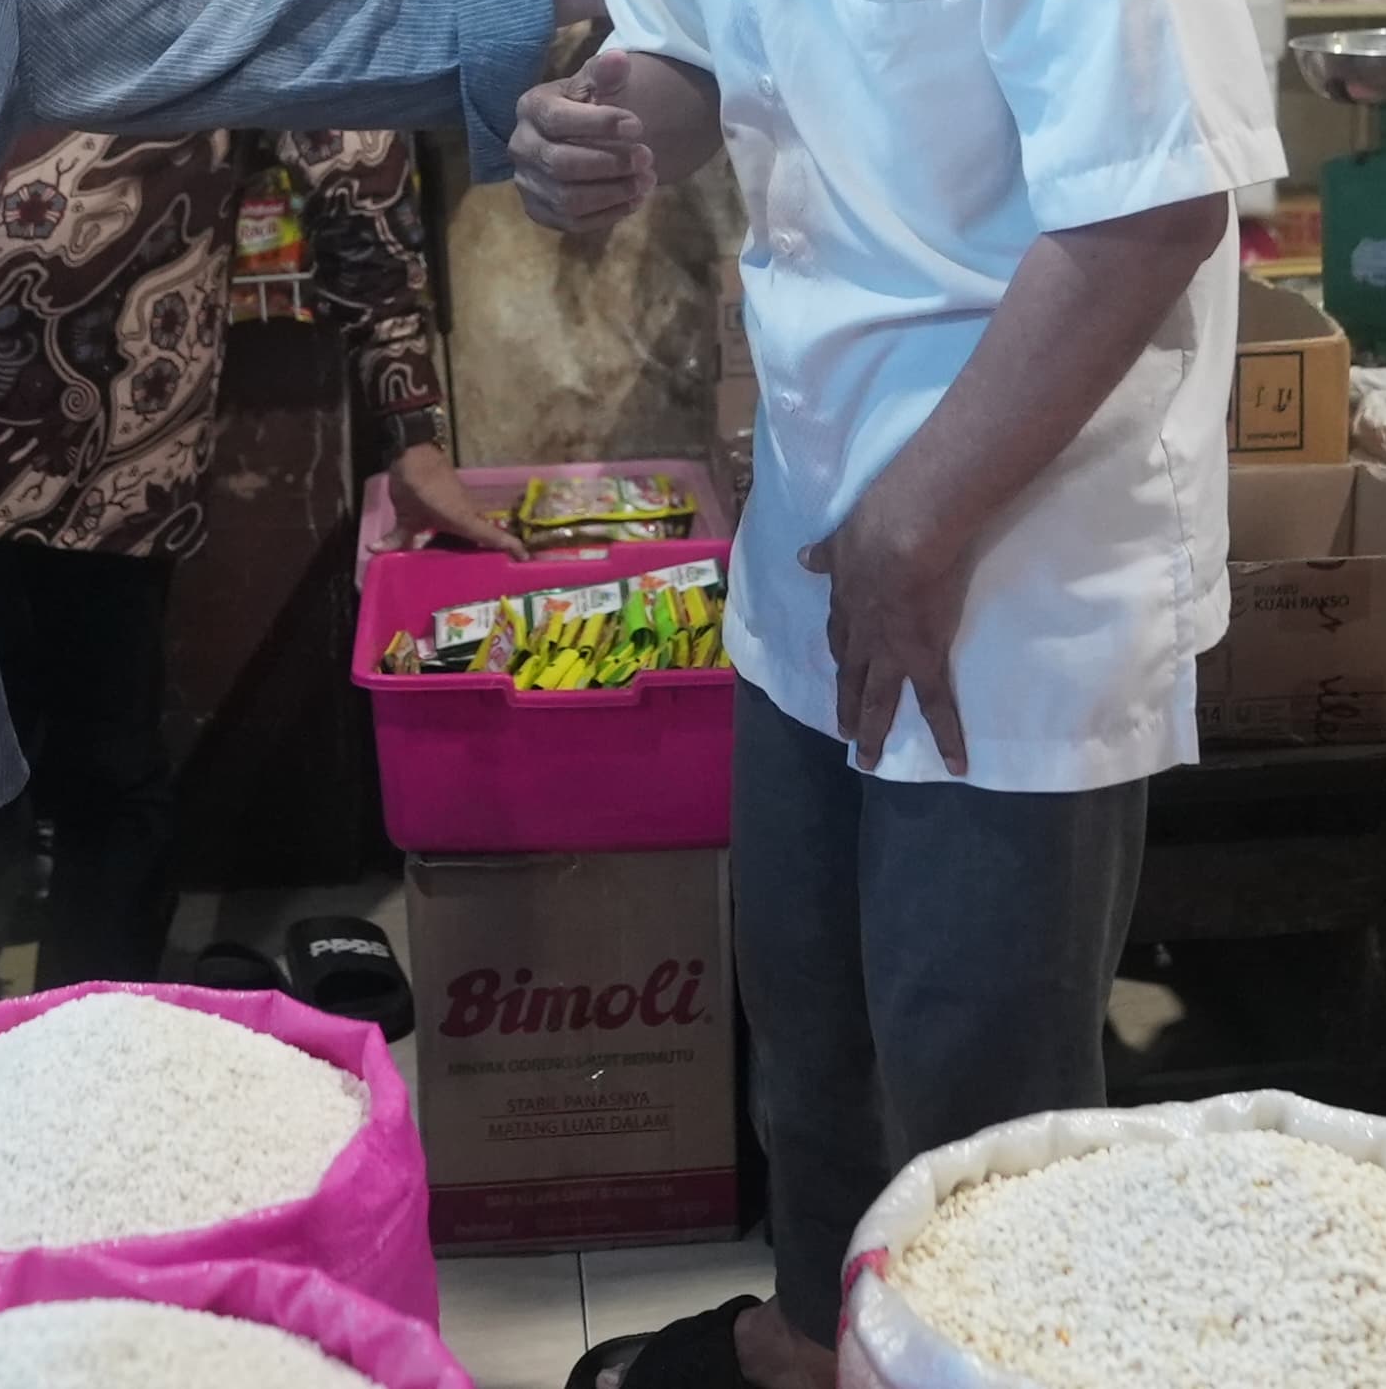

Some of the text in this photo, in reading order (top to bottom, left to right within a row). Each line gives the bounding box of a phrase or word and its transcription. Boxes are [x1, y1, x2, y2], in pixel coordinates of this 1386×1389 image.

[439, 959, 706, 1038] Bimoli
[564, 1090, 650, 1109] PANASNYA
[488, 1113, 668, 1138] MATANG LUAR DALAM
